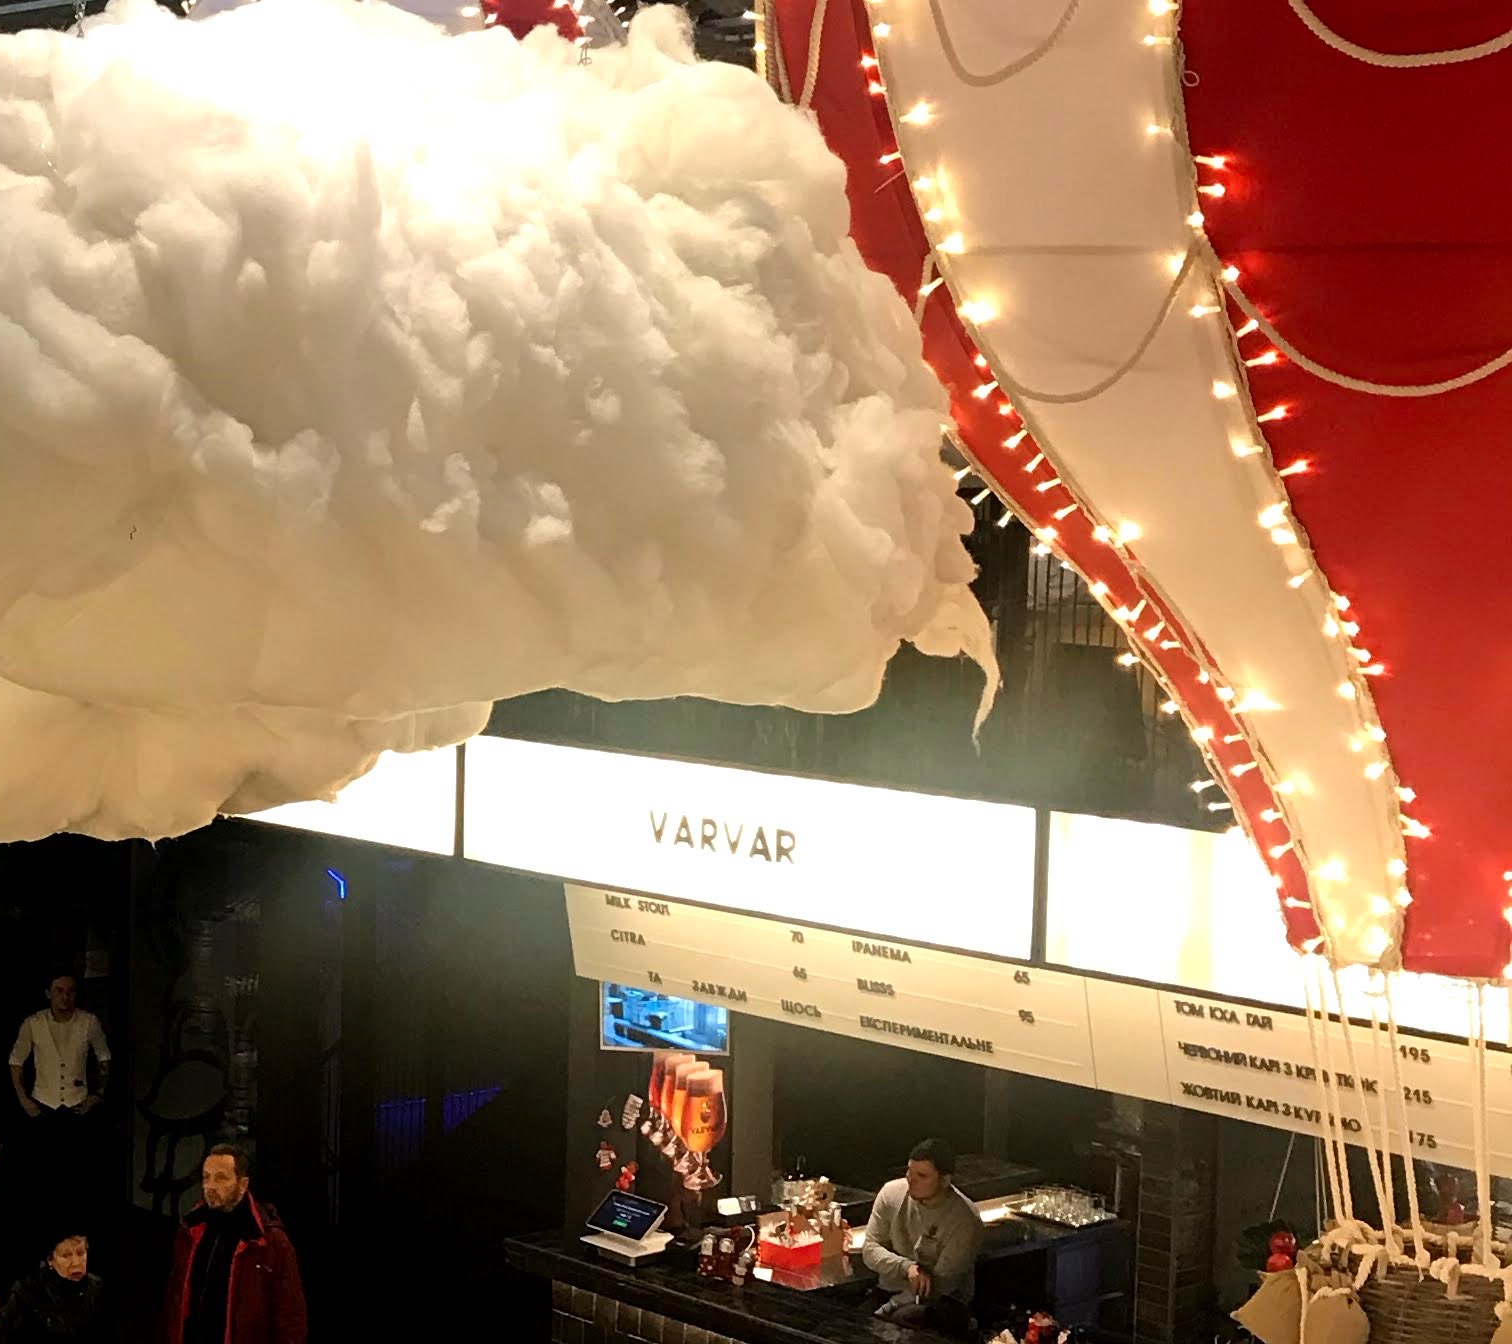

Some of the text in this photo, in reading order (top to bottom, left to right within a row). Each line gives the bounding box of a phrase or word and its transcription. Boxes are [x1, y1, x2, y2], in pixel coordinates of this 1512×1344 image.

[649, 809, 796, 865] VARVAR
[604, 893, 632, 910] MILK
[790, 929, 805, 944] 70
[610, 928, 808, 982] CITRA 65
[851, 939, 1031, 985] IPANEMA 65
[691, 979, 748, 1003] ЗАВЖДИ
[780, 998, 823, 1018] ЩОСЬ
[859, 1014, 994, 1054] ЕКСПЕРИМЕНТАЛЬНЕ
[1018, 1009, 1036, 1024] 95
[1173, 999, 1205, 1019] ТОМ
[1209, 1006, 1241, 1025] КХА
[1399, 1044, 1432, 1063] 195
[1180, 1080, 1242, 1106] ЖОВТИЙ
[1408, 1129, 1438, 1149] 175
[1403, 1085, 1433, 1105] 215
